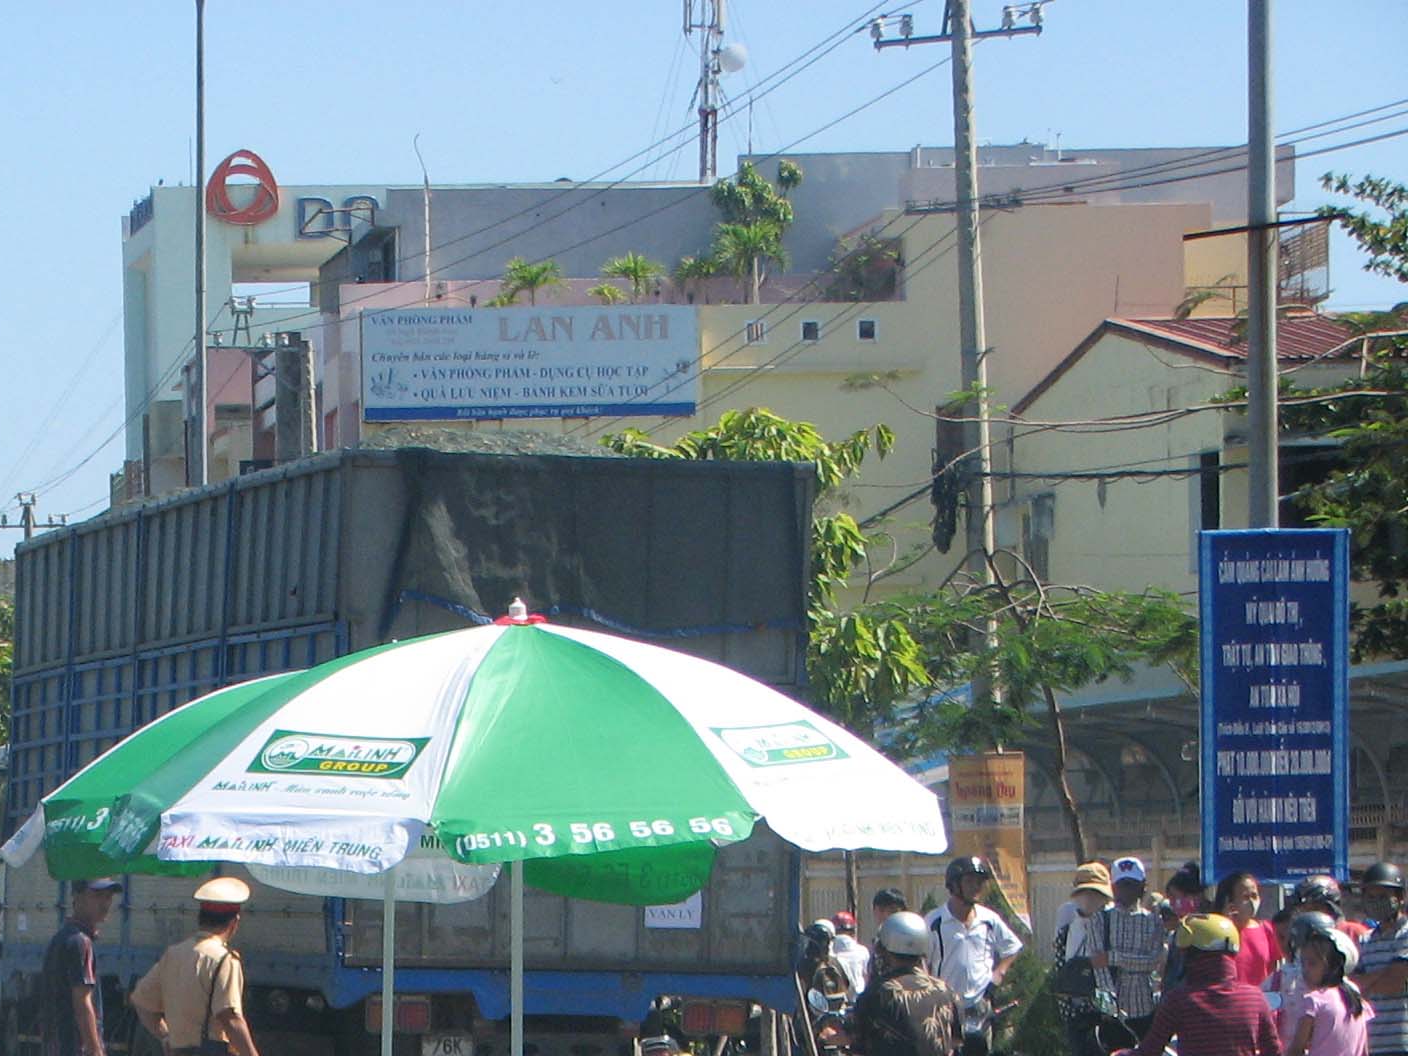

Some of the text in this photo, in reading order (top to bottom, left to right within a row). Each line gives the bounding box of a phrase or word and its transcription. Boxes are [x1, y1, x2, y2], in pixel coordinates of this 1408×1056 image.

[498, 313, 670, 342] LAN ANH
[319, 761, 388, 773] GROUP
[87, 807, 110, 831] 3
[162, 835, 195, 849] TAXI
[329, 840, 383, 861] TRUNG
[456, 816, 734, 857] (0511) 3 56 56 56
